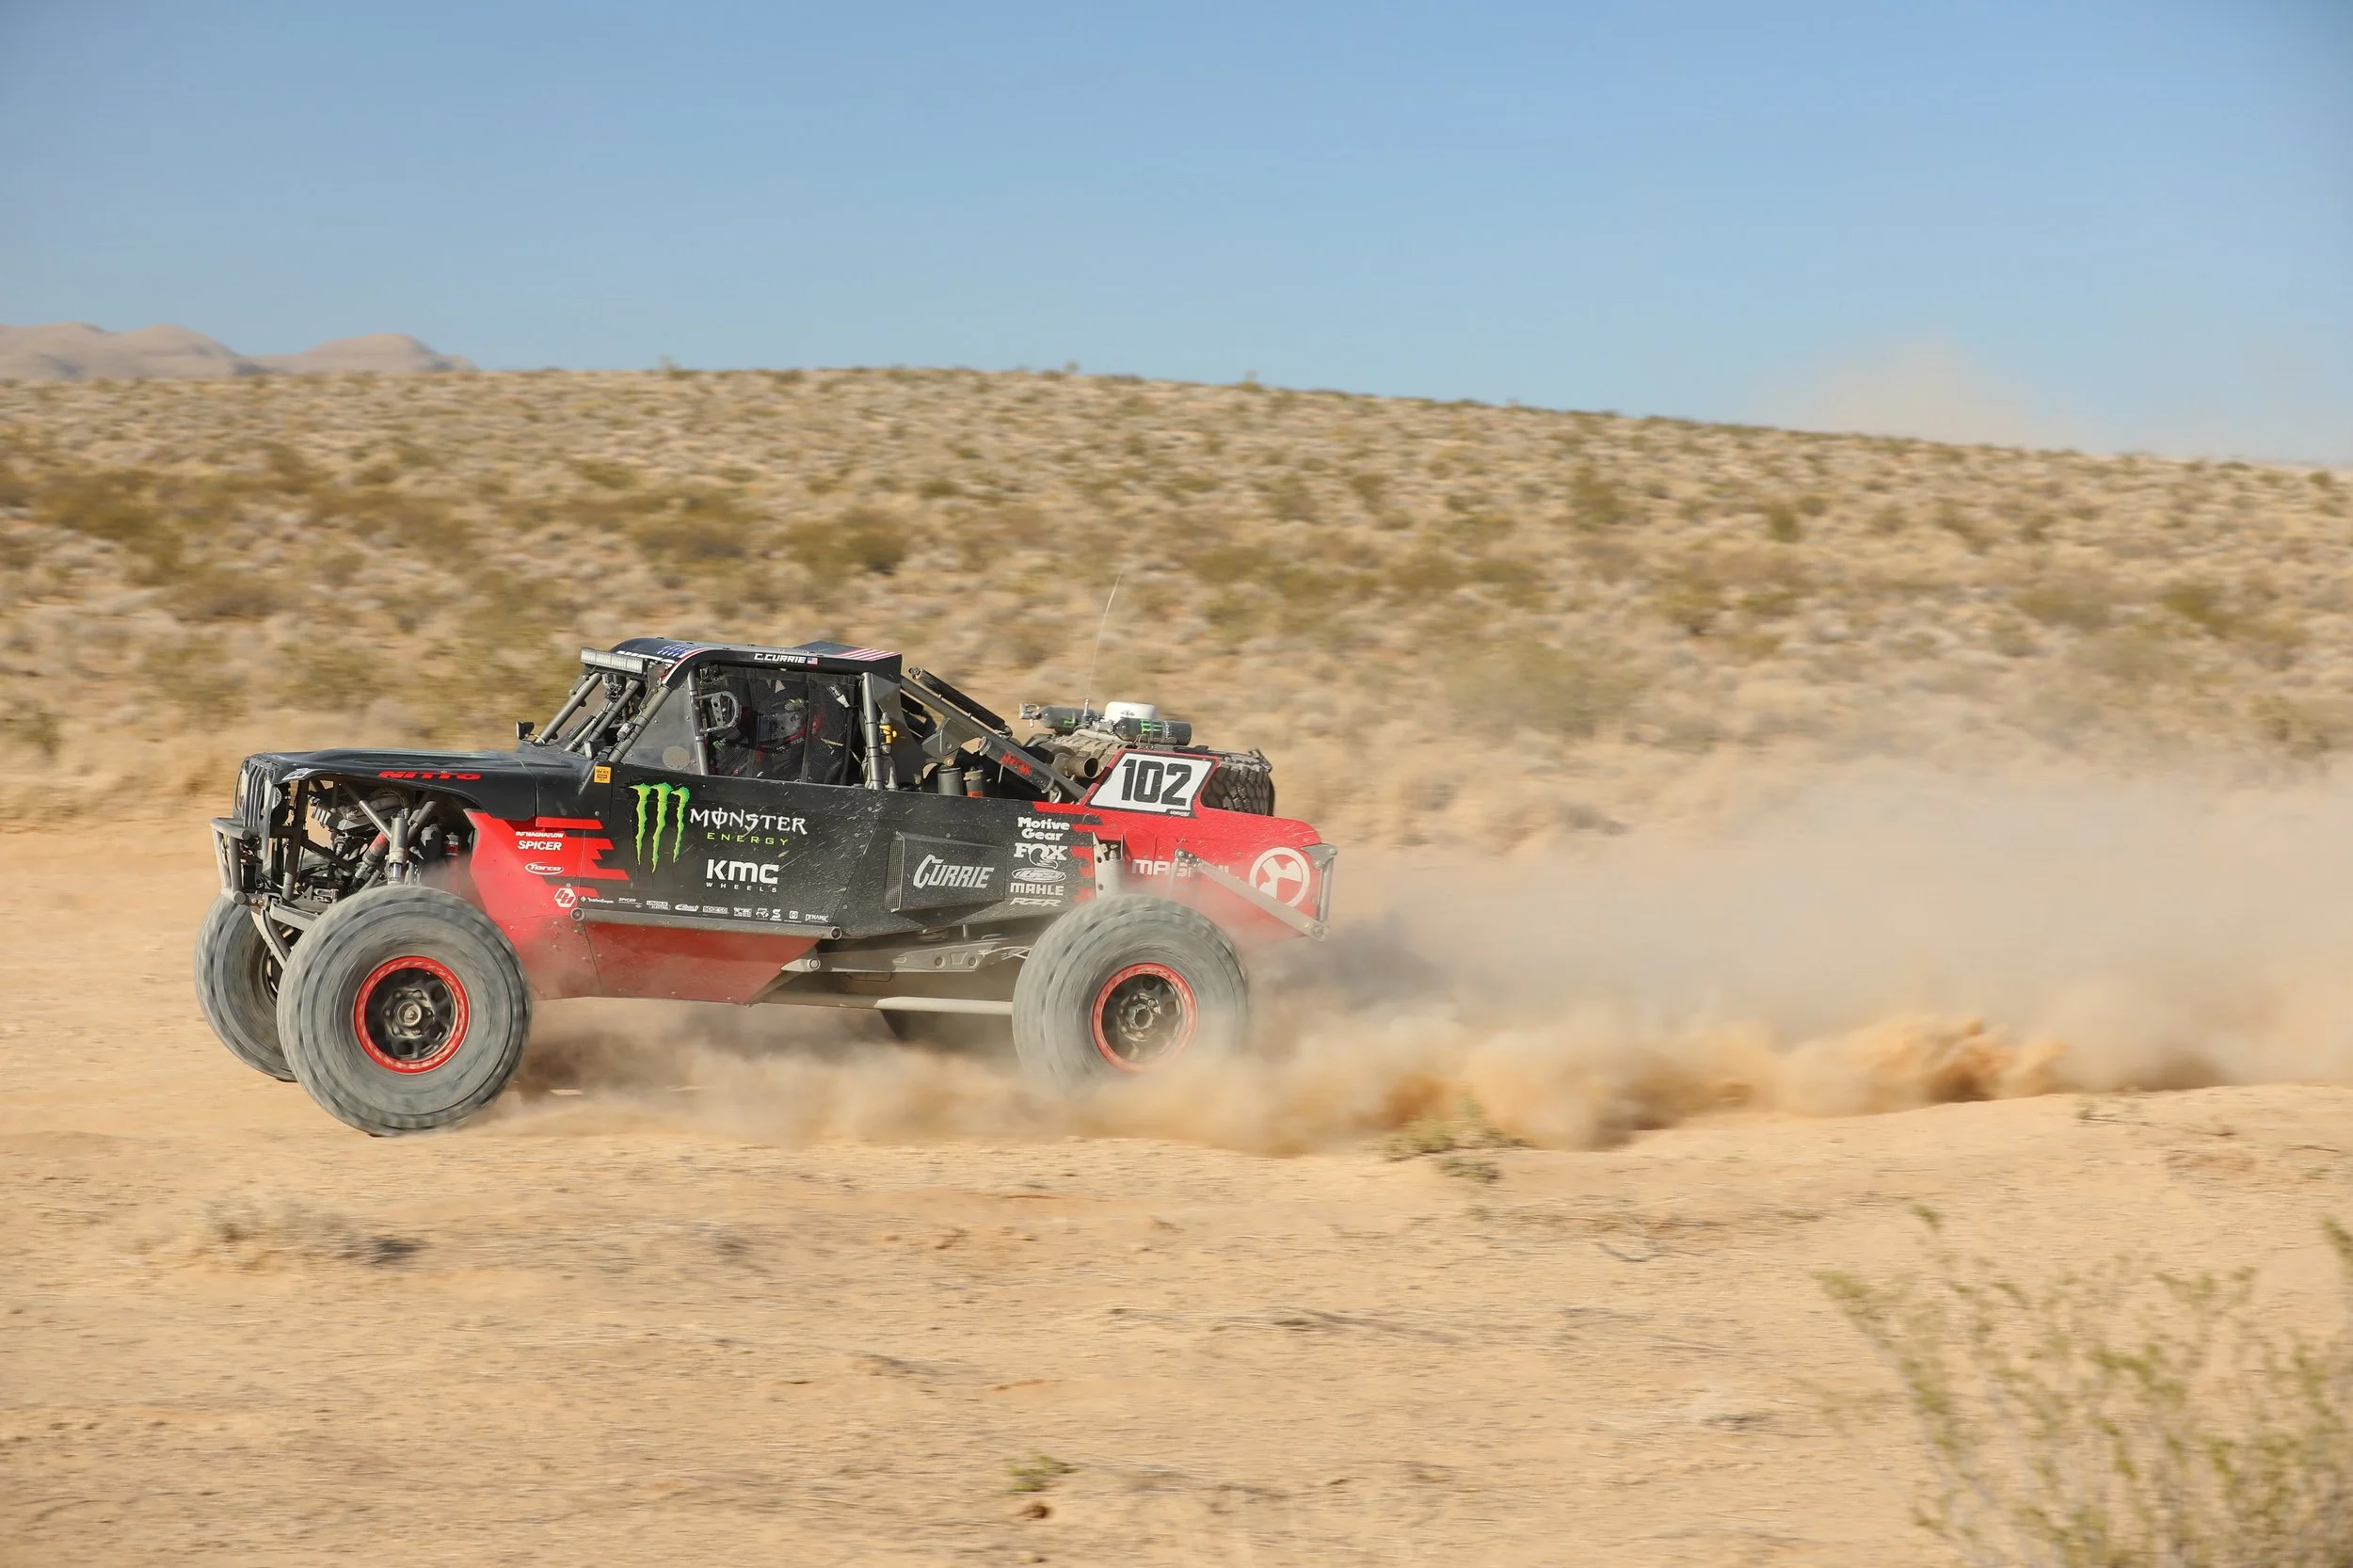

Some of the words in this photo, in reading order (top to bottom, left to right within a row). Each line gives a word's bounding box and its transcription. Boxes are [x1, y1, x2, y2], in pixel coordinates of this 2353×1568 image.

[754, 652, 807, 664] C.CURRIE
[377, 771, 482, 781] NITTO
[1121, 759, 1193, 807] 102
[689, 808, 808, 836] MONSTER
[1017, 817, 1070, 830] Motive
[706, 832, 789, 845] ENERGY
[1021, 828, 1064, 840] Gear
[517, 840, 562, 851] SPICER
[1014, 842, 1068, 869] FOX
[706, 858, 779, 885] KMC
[912, 854, 995, 889] CURRIE
[706, 882, 777, 893] WHEELS
[1010, 882, 1064, 896] MAHLE
